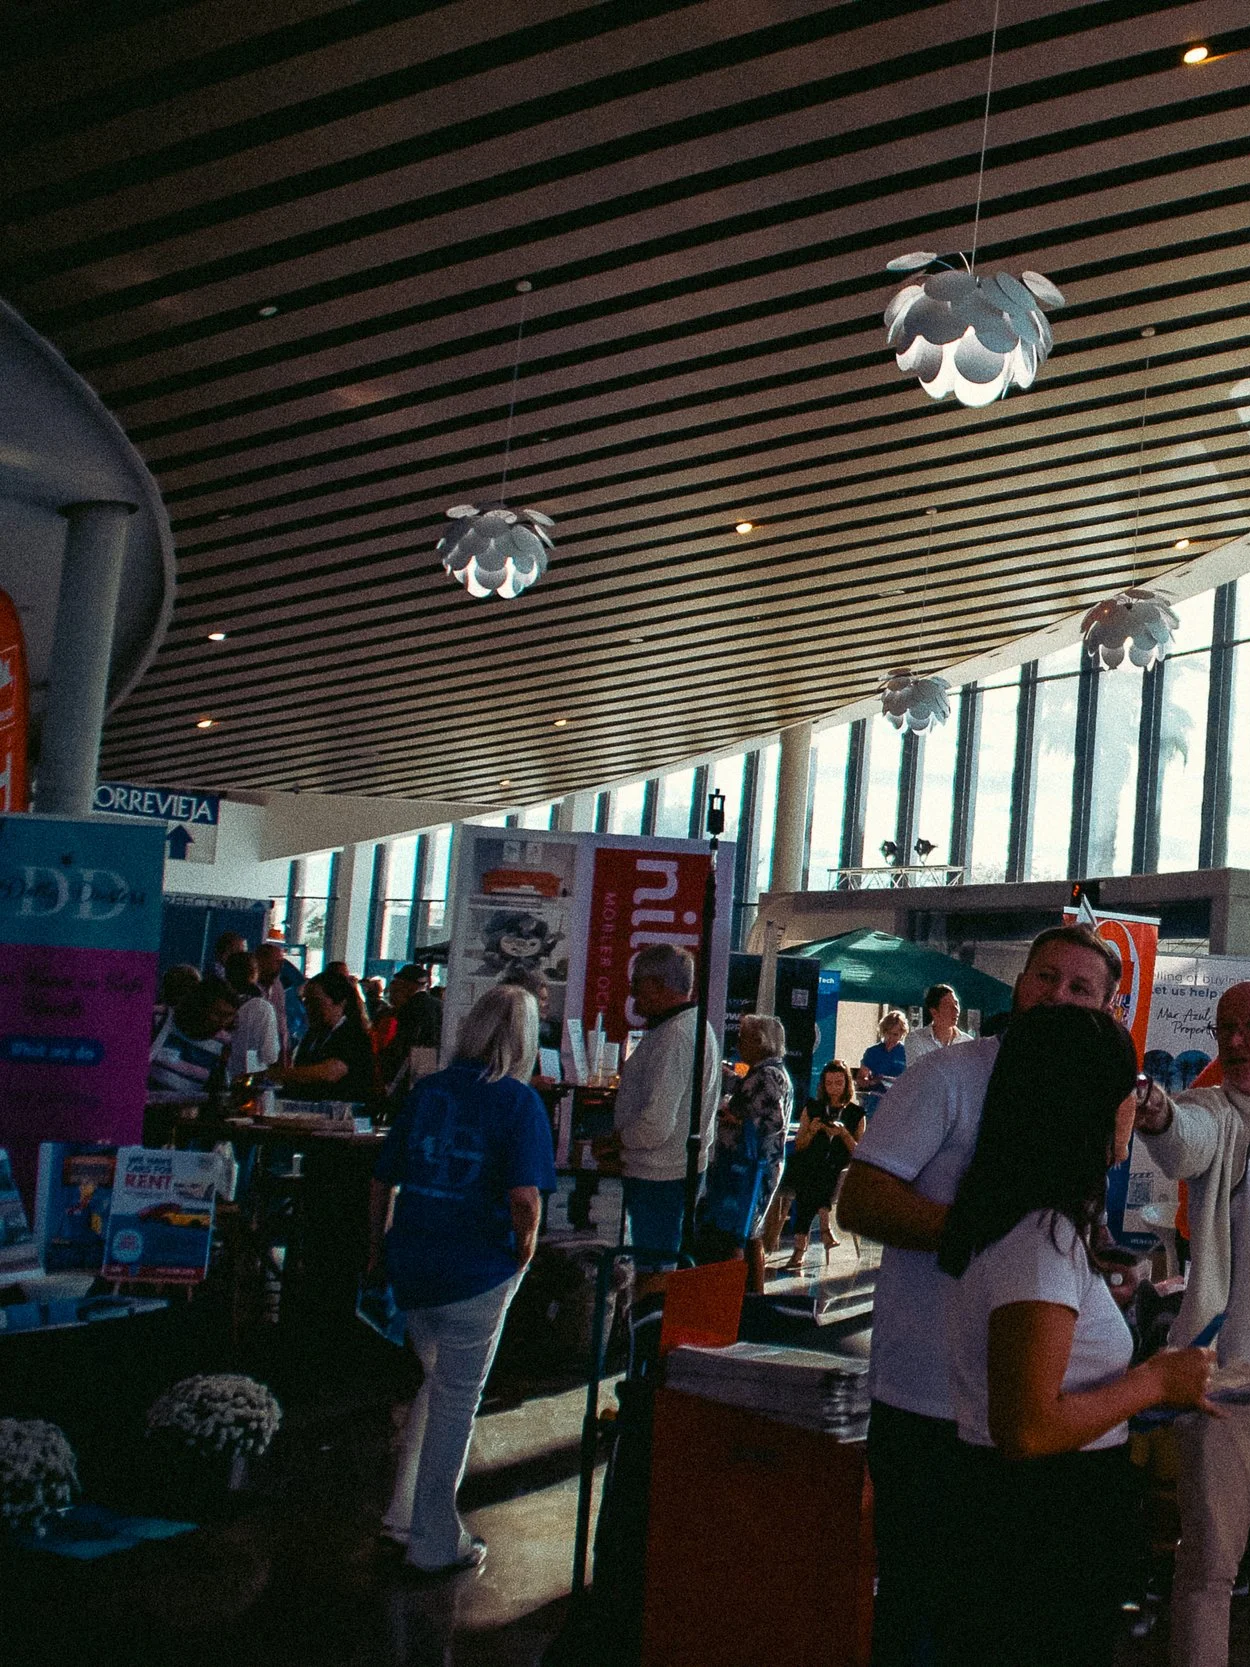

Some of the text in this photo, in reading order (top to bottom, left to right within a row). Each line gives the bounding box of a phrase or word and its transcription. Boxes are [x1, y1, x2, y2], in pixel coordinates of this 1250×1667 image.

[95, 785, 213, 822] ORREVIEJA
[1151, 986, 1218, 1000] et us help
[1183, 1006, 1212, 1023] Azul
[125, 1174, 172, 1190] RENT
